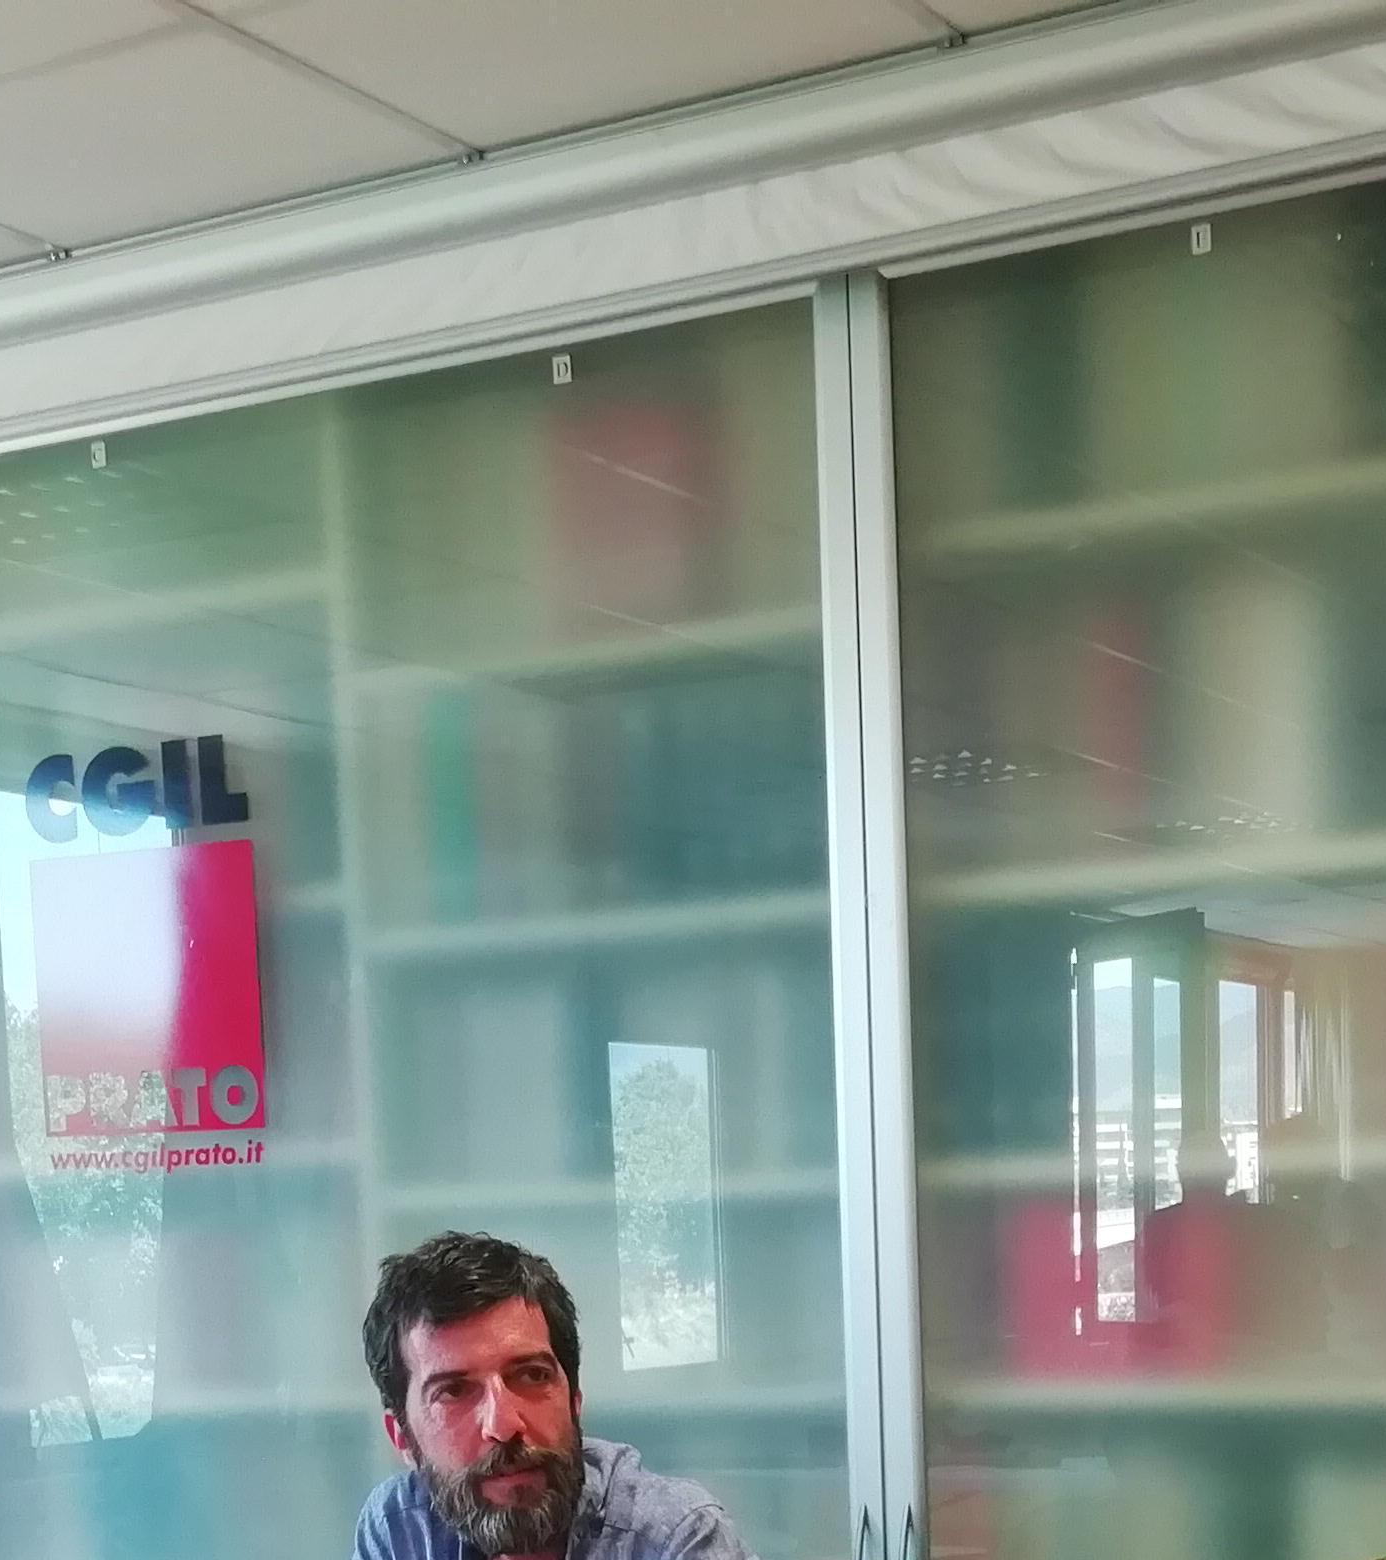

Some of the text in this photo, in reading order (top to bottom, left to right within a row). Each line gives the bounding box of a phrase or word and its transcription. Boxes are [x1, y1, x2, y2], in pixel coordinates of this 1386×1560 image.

[557, 361, 569, 377] D
[26, 734, 250, 843] CGIL
[47, 1065, 259, 1132] PRATO
[50, 1140, 265, 1174] www.cgilprato.it
